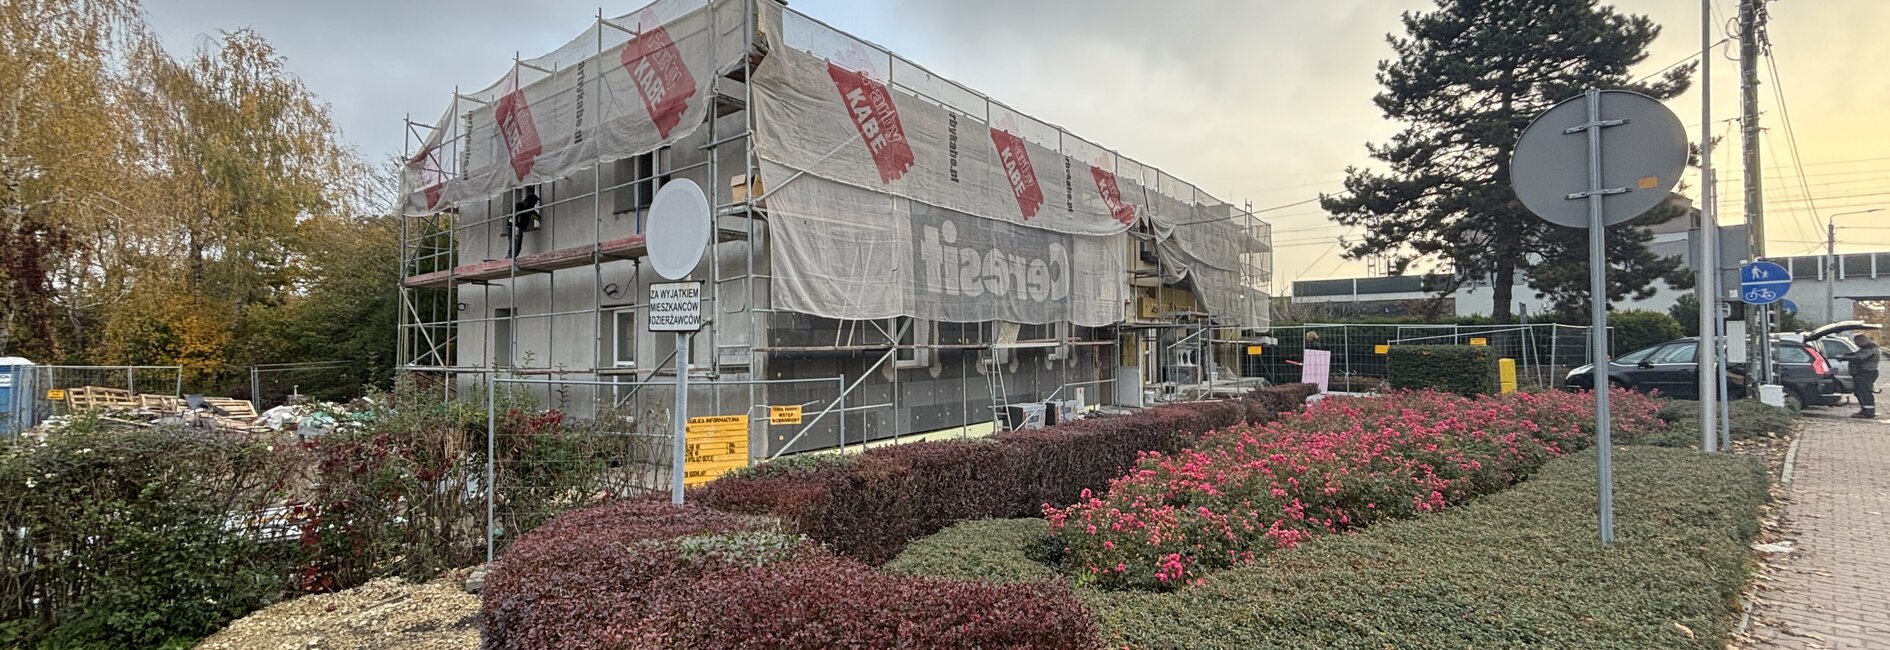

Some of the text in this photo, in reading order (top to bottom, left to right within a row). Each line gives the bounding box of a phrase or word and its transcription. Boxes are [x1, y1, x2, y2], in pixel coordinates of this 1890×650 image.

[634, 54, 666, 112] KABE
[503, 110, 524, 158] KABE
[846, 86, 887, 155] KABE
[1001, 146, 1026, 197] KABE
[650, 301, 699, 312] MIESZKAŃCÓW
[651, 288, 699, 300] ZA WYJĄTKIEM
